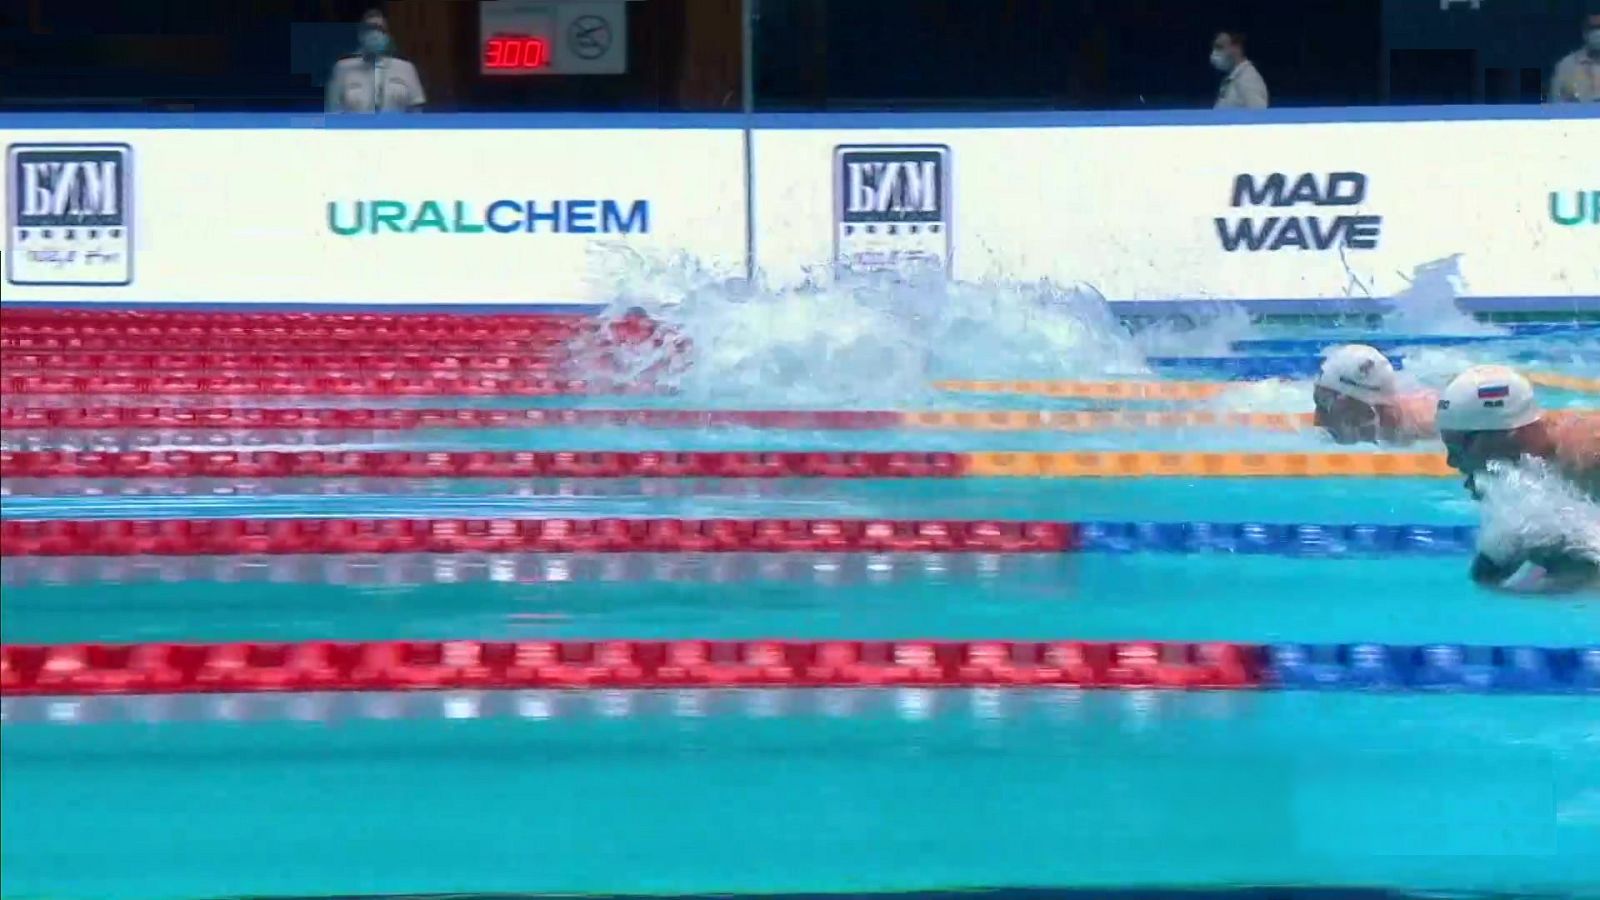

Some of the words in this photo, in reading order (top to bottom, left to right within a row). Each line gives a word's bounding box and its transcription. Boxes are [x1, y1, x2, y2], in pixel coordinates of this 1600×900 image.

[21, 160, 119, 216] БИМ
[847, 160, 937, 212] БИМ
[1231, 171, 1367, 207] MAD
[327, 199, 650, 235] URALCHEM
[1548, 190, 1600, 225] U
[1215, 215, 1382, 251] WAVE
